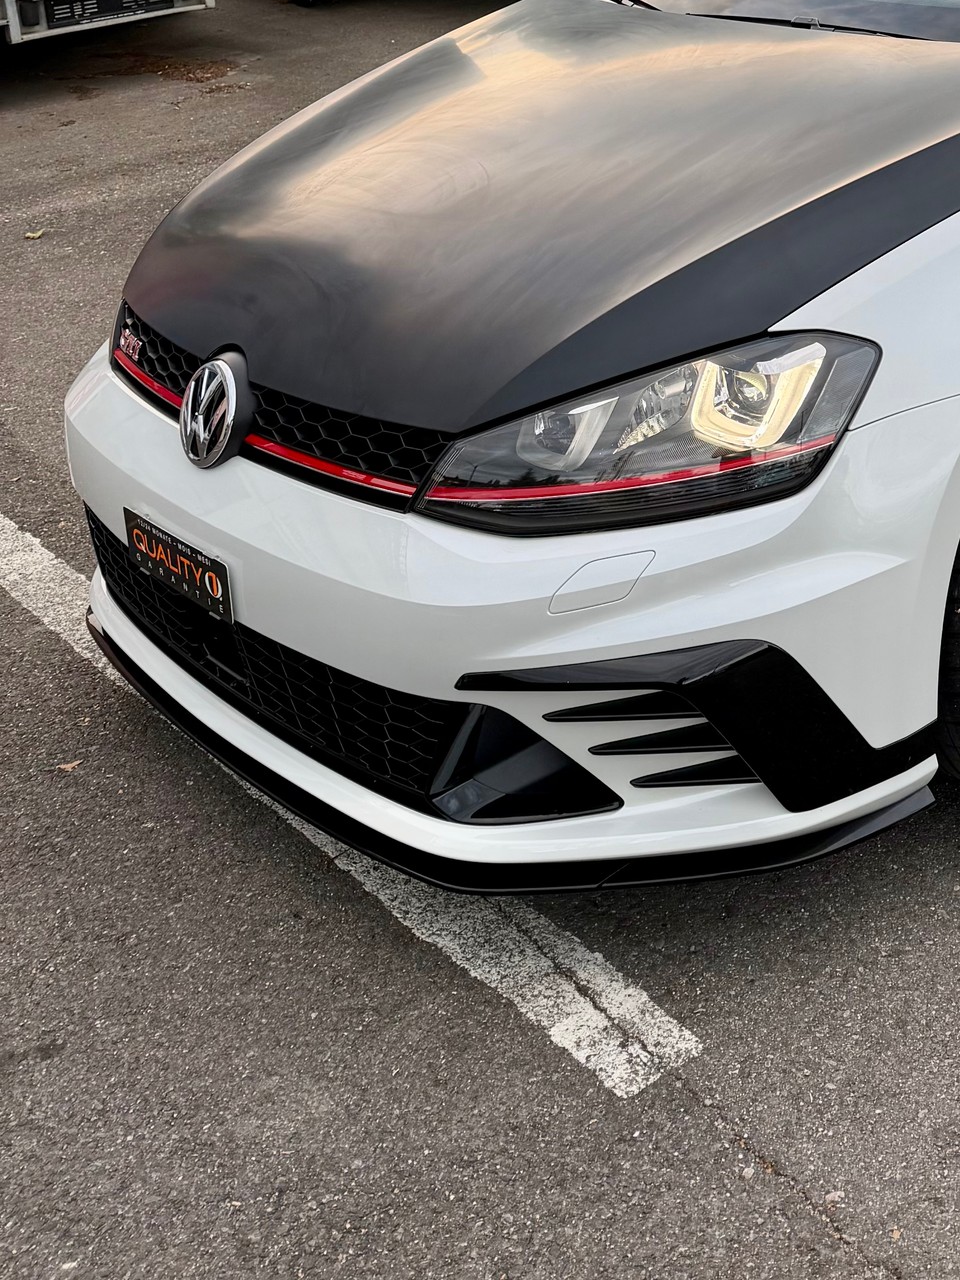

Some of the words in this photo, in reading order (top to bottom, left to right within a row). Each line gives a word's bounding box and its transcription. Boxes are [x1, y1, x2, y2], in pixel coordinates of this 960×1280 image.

[120, 328, 142, 361] GTI
[133, 528, 202, 587] QUALITY
[136, 552, 224, 614] GARANTIE
